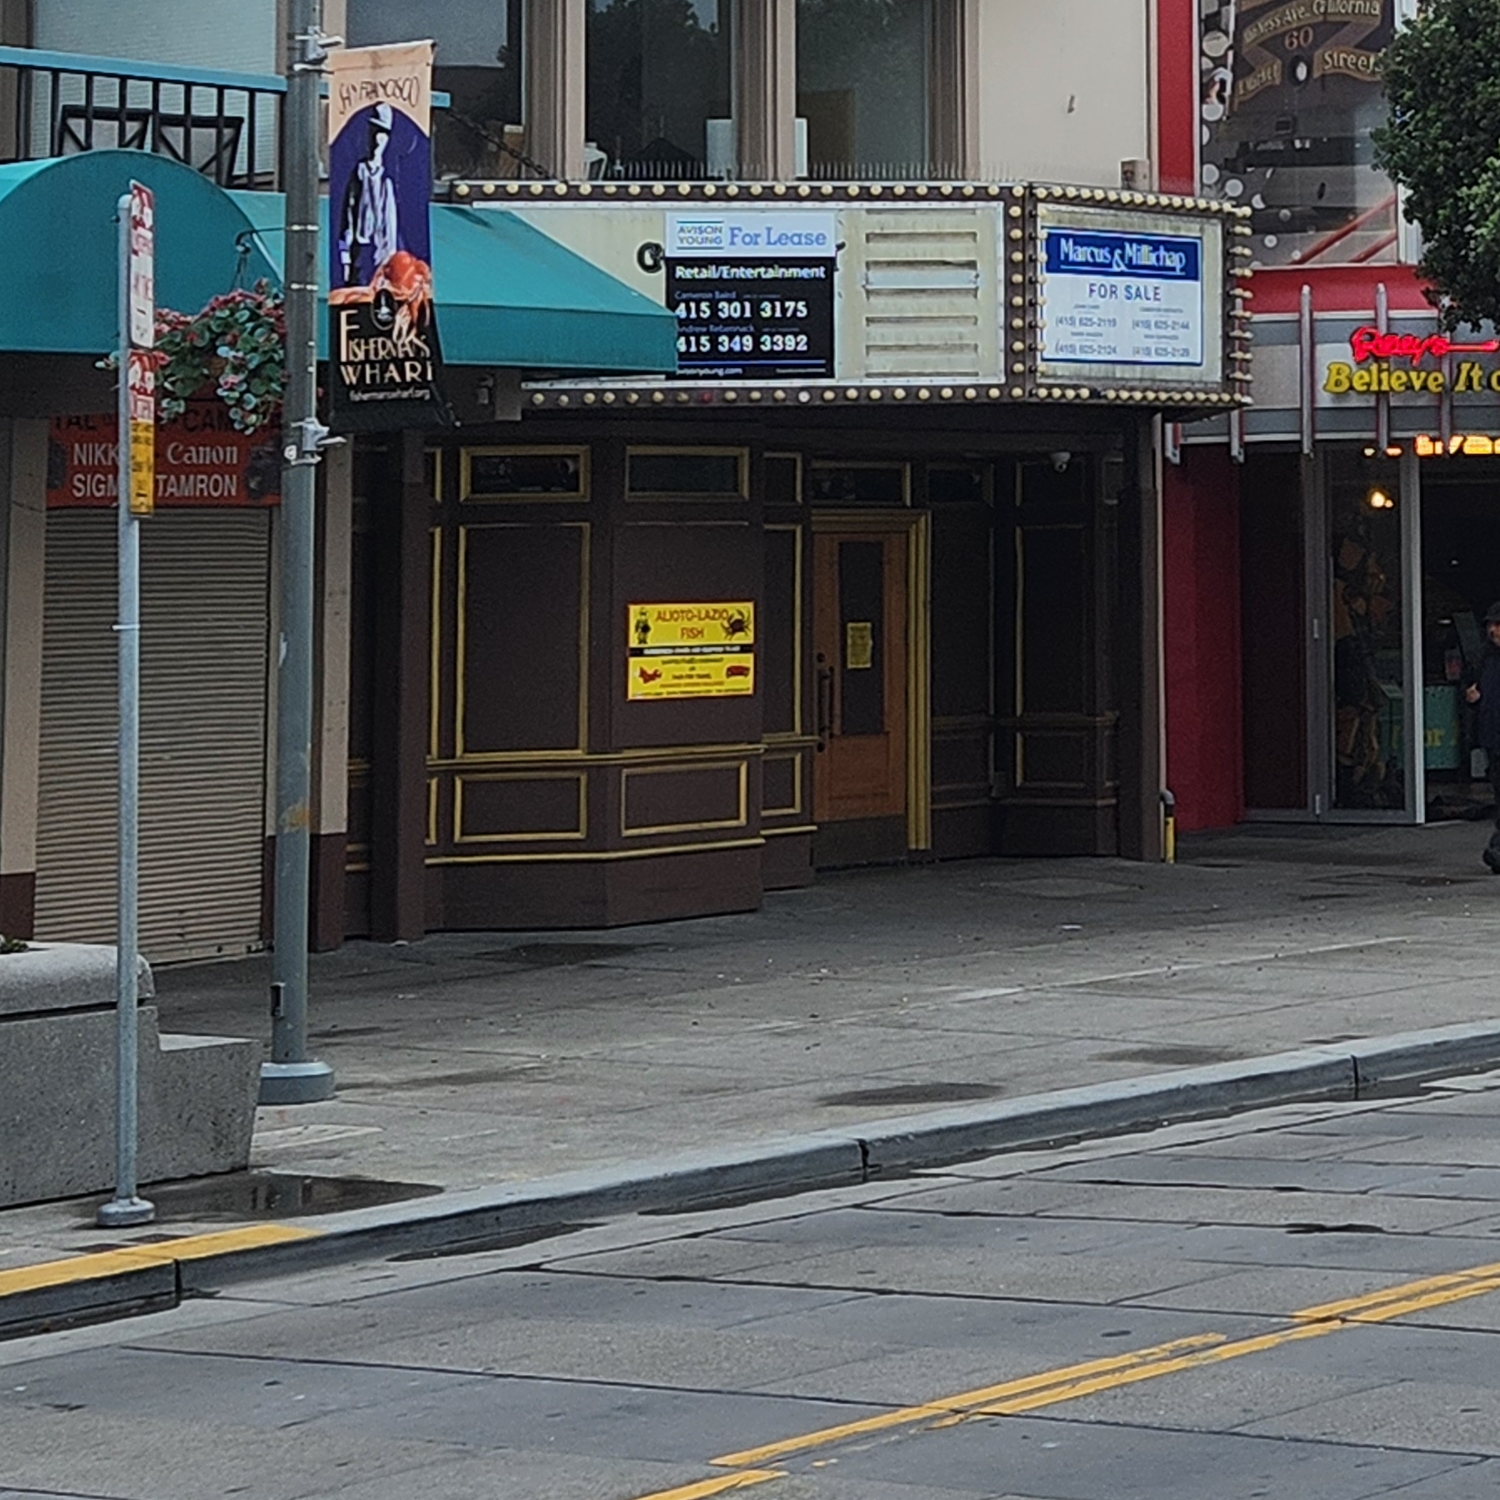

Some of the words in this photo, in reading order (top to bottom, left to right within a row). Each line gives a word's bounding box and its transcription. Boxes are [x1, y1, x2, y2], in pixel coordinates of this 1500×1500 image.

[1284, 26, 1314, 50] 60
[678, 226, 723, 235] AVISON
[729, 227, 761, 246] For
[765, 226, 827, 246] Lease
[678, 236, 723, 245] YOUNG
[1060, 237, 1111, 264] Marcus
[1112, 248, 1127, 272] &
[1125, 242, 1186, 275] Millichap
[675, 265, 826, 279] Retail/Entertainment
[1089, 283, 1118, 300] FOR
[1124, 285, 1162, 301] SALE
[675, 301, 711, 319] 415
[718, 301, 752, 319] 301
[760, 301, 808, 318] 3175
[676, 335, 711, 352] 415
[718, 335, 753, 352] 349
[760, 335, 808, 352] 3392
[1324, 362, 1445, 394] Believe
[1454, 361, 1484, 393] It
[167, 441, 238, 466] Canon
[155, 474, 238, 498] TAMRON
